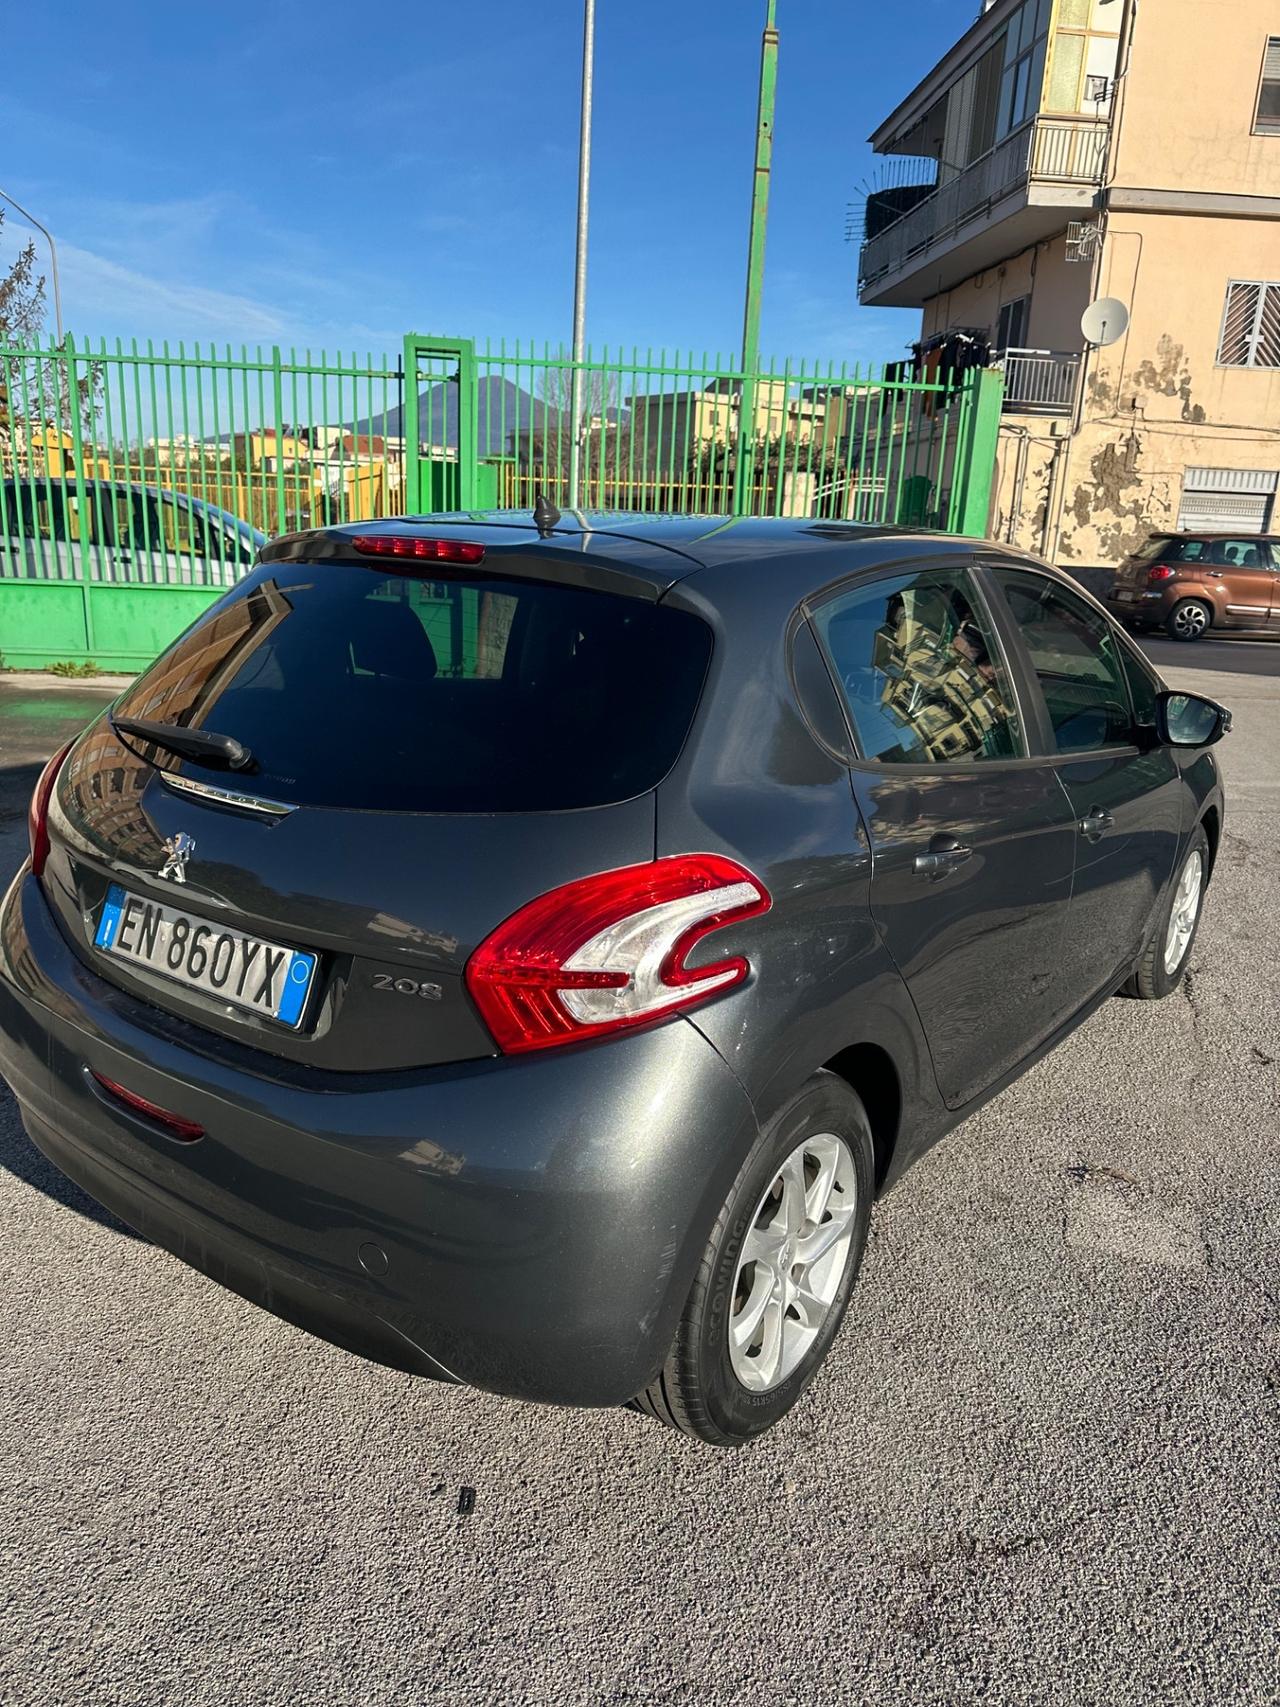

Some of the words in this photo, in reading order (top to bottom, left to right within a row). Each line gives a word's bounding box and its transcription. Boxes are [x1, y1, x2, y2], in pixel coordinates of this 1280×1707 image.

[117, 896, 163, 960] EN
[167, 917, 286, 1008] 860YX
[372, 974, 442, 1001] 208
